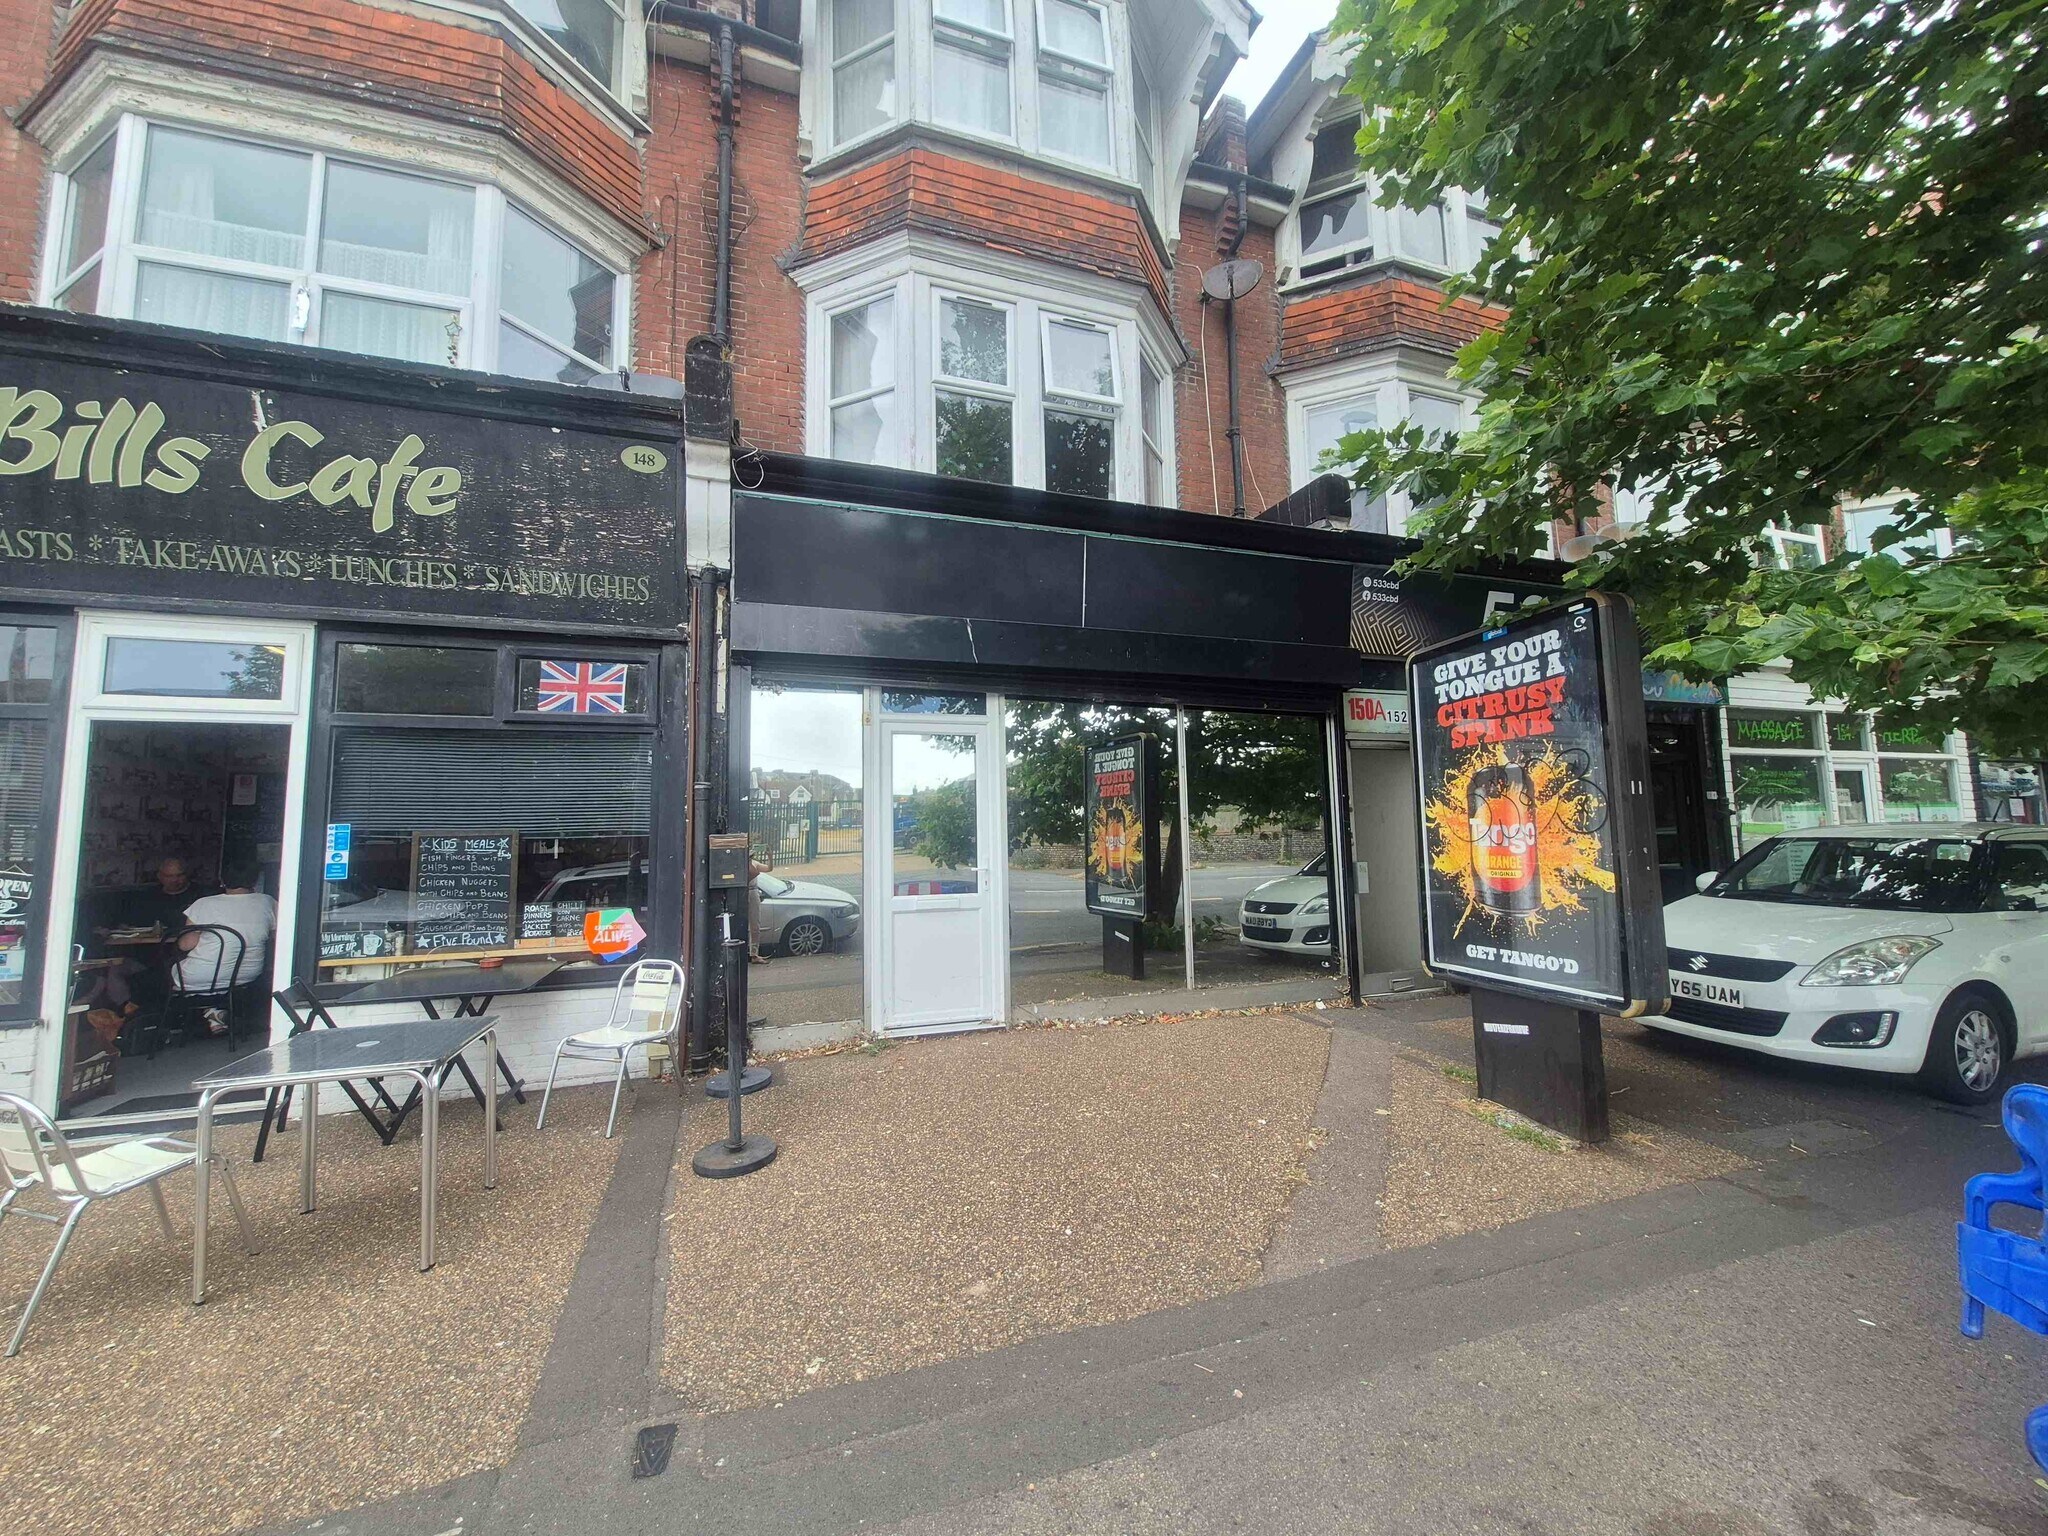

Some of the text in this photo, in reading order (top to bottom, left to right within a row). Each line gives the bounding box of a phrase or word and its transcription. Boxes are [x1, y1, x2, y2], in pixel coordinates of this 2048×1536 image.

[0, 386, 462, 534] Bills Cafe
[632, 451, 656, 468] 148
[111, 535, 301, 578] TAKE-AWAYS
[330, 553, 458, 590] LUNCHES
[484, 564, 651, 602] SANDWICHES
[1373, 578, 1400, 590] 533cbd
[1372, 592, 1399, 603] 533cbd
[1433, 629, 1563, 684] GIVE YOUR
[1434, 652, 1566, 704] TONGUE A
[1437, 675, 1567, 728] CITRUSY
[1347, 697, 1408, 723] 150A 152
[1451, 707, 1555, 750] SPANK
[1737, 720, 1805, 740] MASSAGE
[1469, 817, 1537, 854] Tango
[465, 839, 495, 849] MEALS
[421, 853, 441, 862] FISH
[470, 861, 496, 871] BEANS
[419, 876, 498, 887] CHICKEN NUGGETS
[440, 888, 464, 897] CHIPS
[479, 888, 509, 899] BEANS
[417, 901, 489, 911] CHICKEN POPS
[524, 904, 550, 913] ROAST
[439, 911, 466, 919] CHIPS
[482, 910, 509, 919] BEANS
[523, 911, 552, 920] DINNERS
[522, 923, 550, 931] JACKET
[592, 928, 634, 944] ALIVE
[321, 941, 357, 955] WAKE UP
[1466, 943, 1580, 975] GET TANGO'D
[1706, 984, 1741, 1005] UAM
